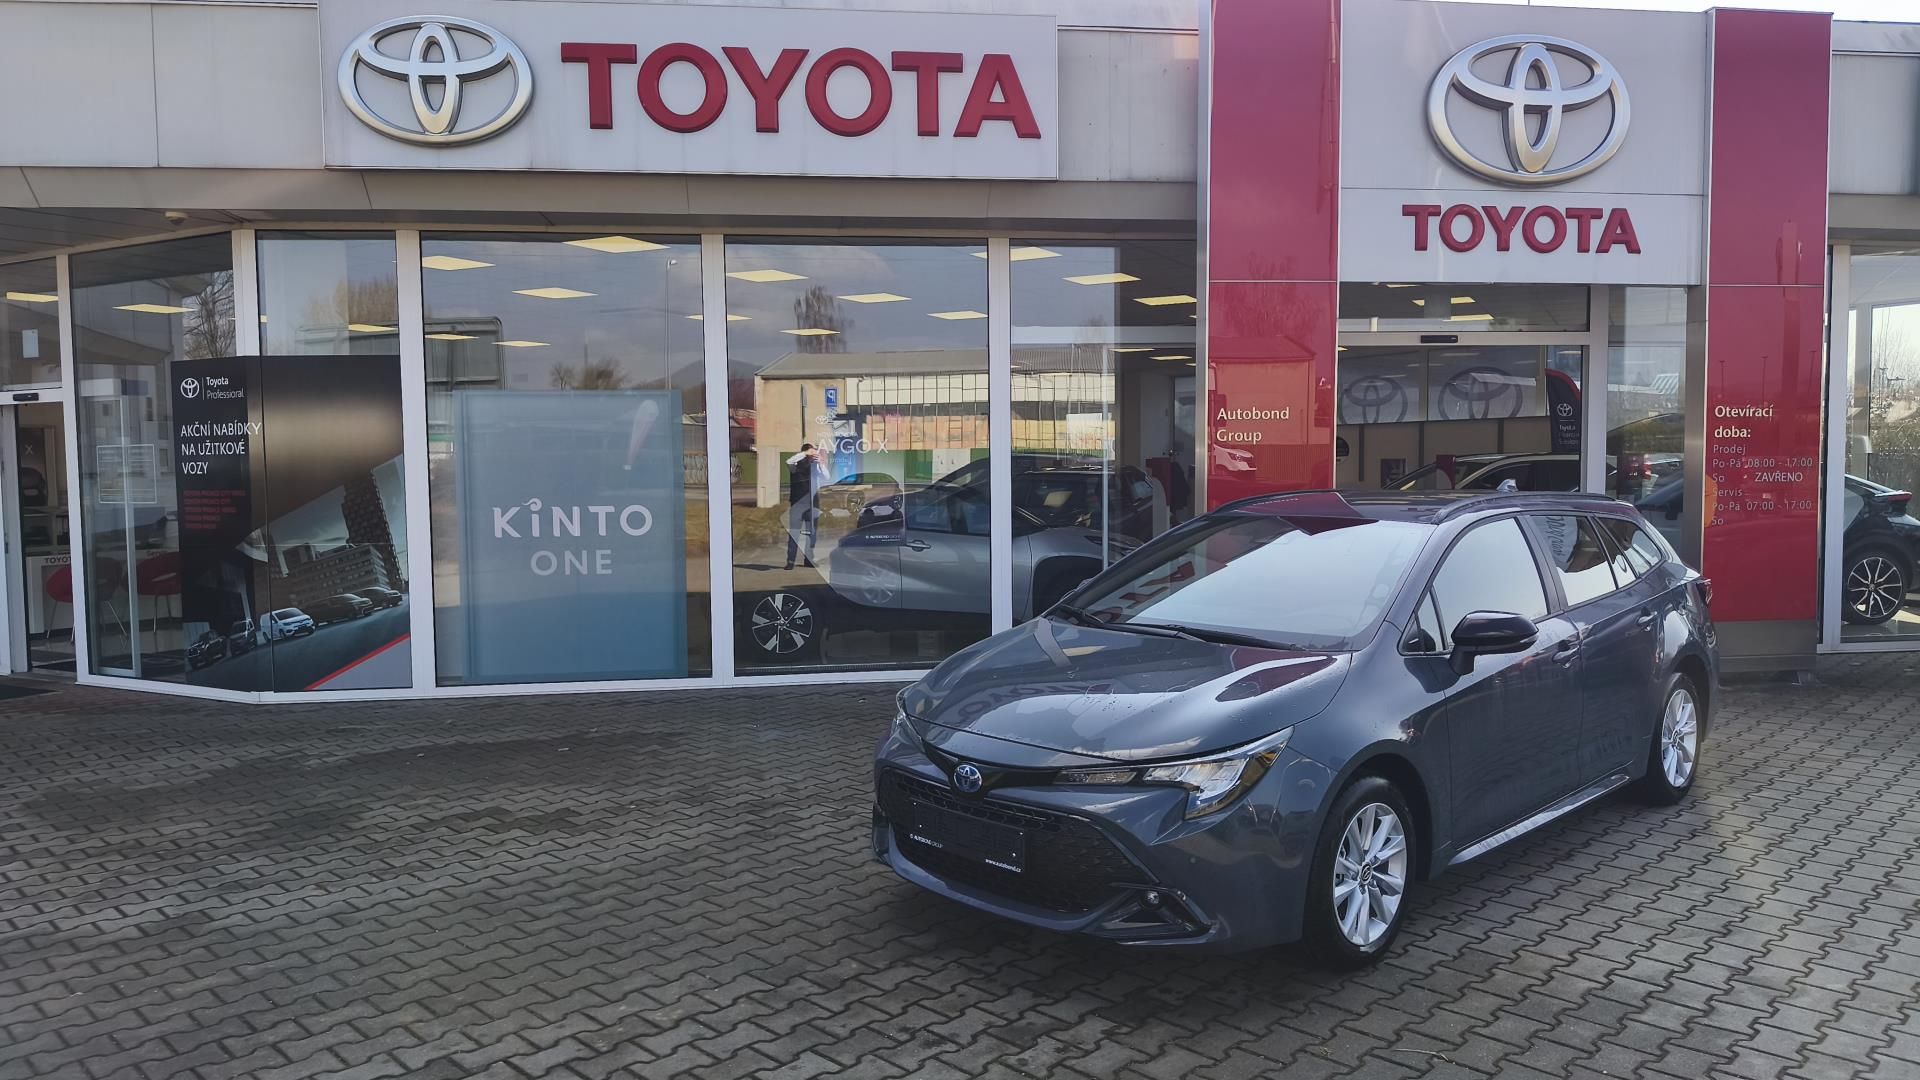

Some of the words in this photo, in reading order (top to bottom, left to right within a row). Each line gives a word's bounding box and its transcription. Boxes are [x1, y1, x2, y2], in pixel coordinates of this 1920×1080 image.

[561, 42, 1041, 139] TOYOTA
[1402, 204, 1641, 254] TOYOTA
[206, 376, 228, 387] Toyota
[207, 388, 244, 399] Professional
[1217, 406, 1290, 421] Autobond
[1714, 405, 1773, 418] Otevírací
[180, 421, 211, 437] AKČNÍ
[213, 420, 262, 436] NABÍDKY
[1714, 426, 1751, 438] doba:
[1216, 429, 1262, 446] Group
[181, 443, 196, 456] NA
[199, 439, 246, 455] UŽITKOVÉ
[816, 438, 872, 454] AYGO
[876, 438, 889, 454] X
[1713, 444, 1746, 456] Prodej
[182, 462, 208, 475] VOZY
[1747, 458, 1775, 468] 08:00
[1786, 457, 1813, 468] 17:00
[1712, 473, 1725, 483] So
[1754, 470, 1803, 482] ZAVŘENO
[1712, 488, 1743, 497] Servis
[1746, 501, 1774, 511] 07:00
[1711, 516, 1724, 526] So
[530, 549, 612, 576] ONE
